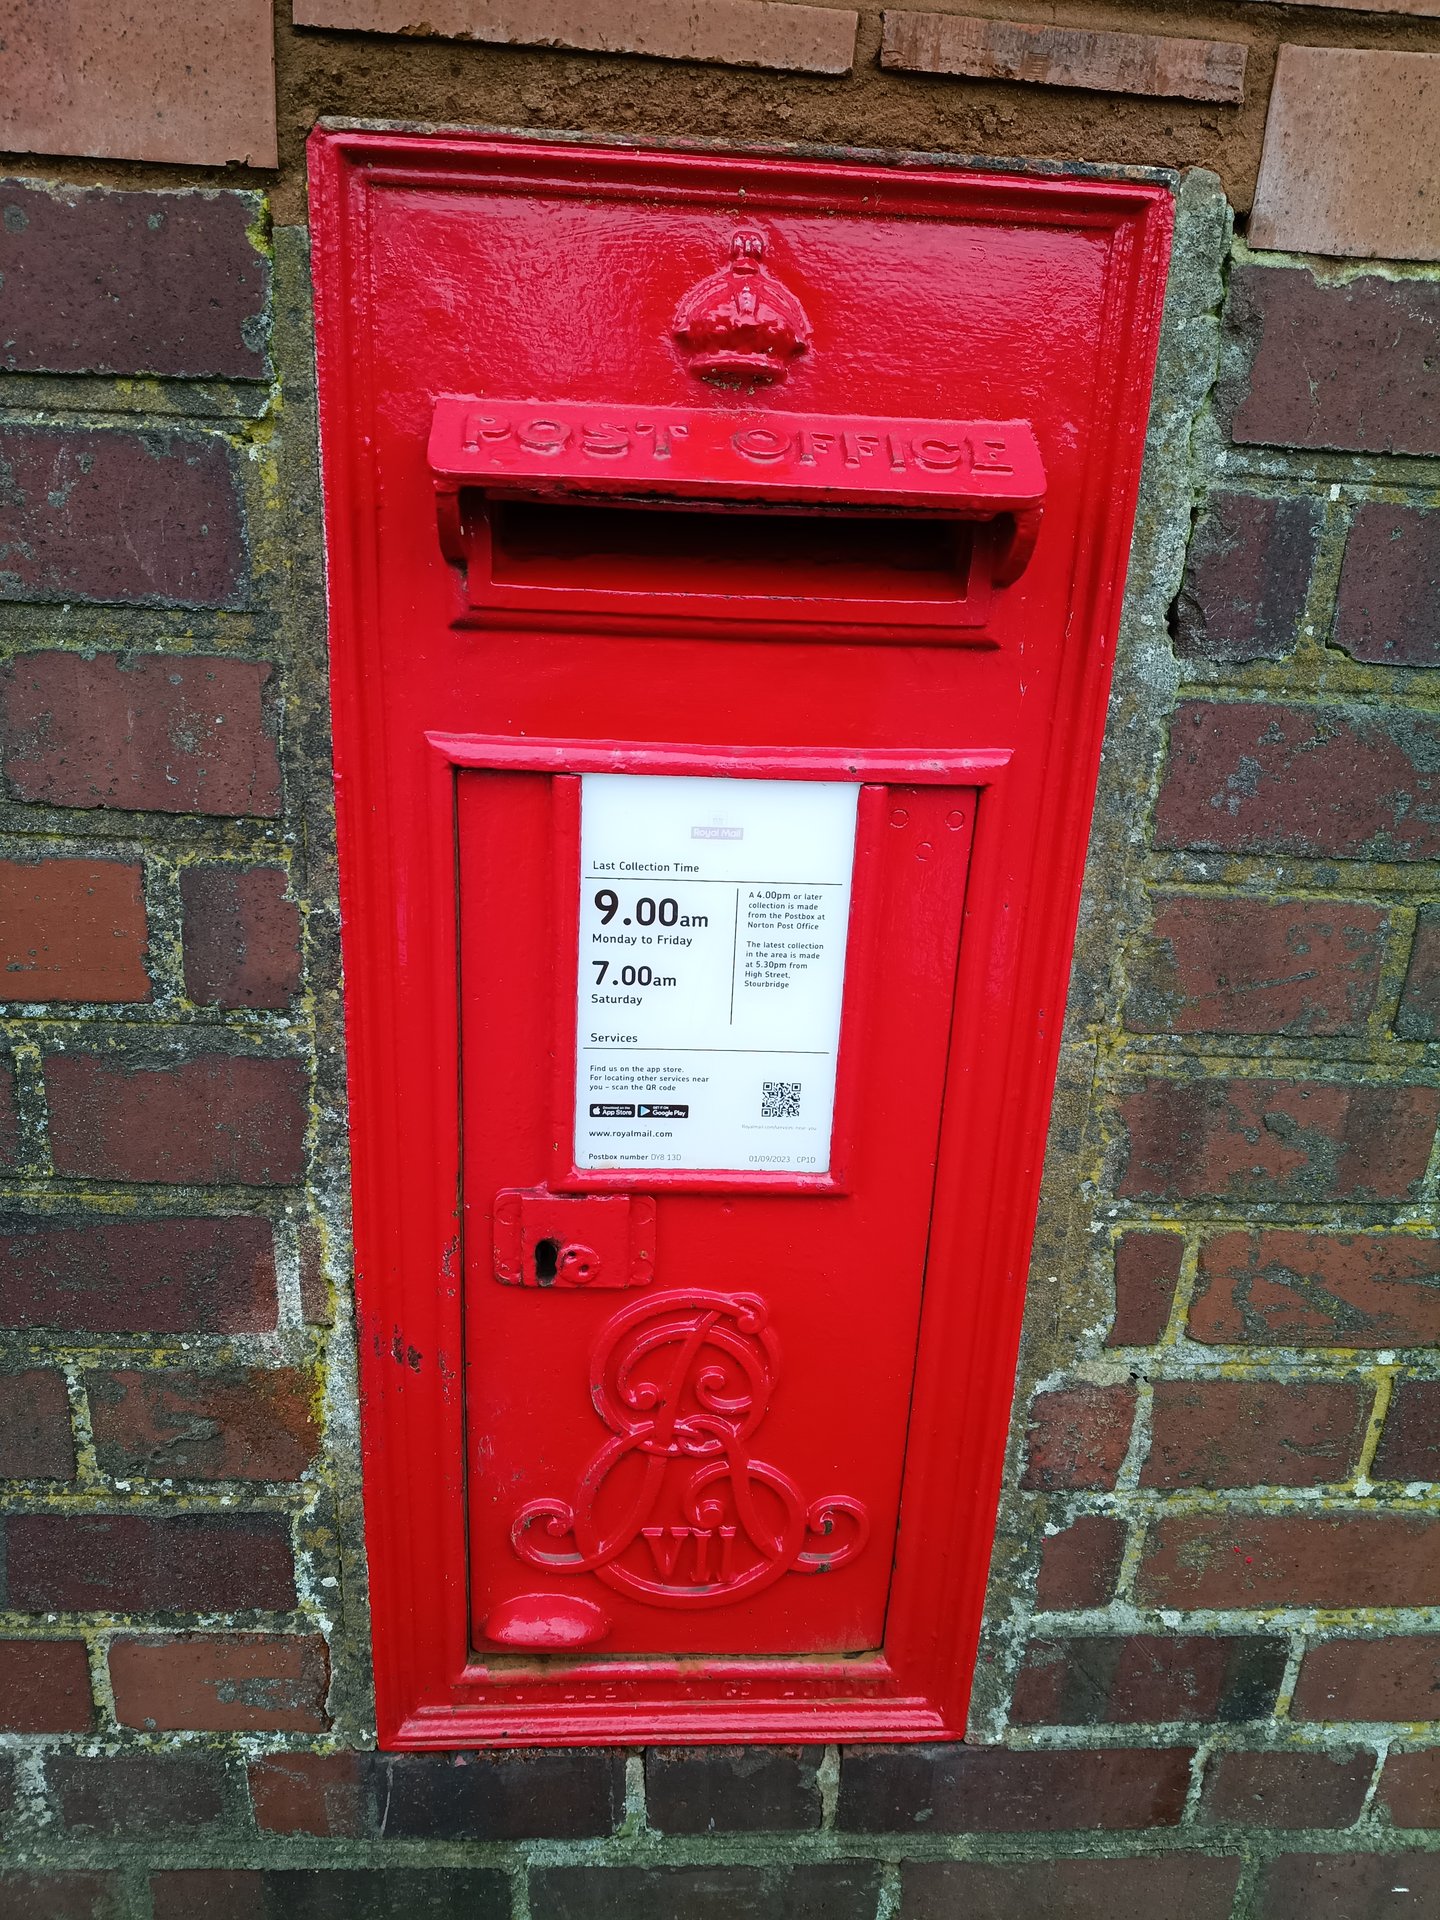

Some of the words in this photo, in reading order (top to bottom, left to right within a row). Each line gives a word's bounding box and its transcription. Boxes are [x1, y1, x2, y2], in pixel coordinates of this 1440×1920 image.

[463, 413, 689, 460] POST
[734, 428, 1015, 475] OFFICE
[693, 828, 719, 838] Royal
[721, 829, 741, 838] Mail
[593, 861, 615, 871] Last
[619, 861, 669, 872] Collection
[674, 863, 699, 872] Time
[757, 891, 791, 900] 4.00pm
[805, 893, 822, 901] later
[594, 889, 708, 927] 9.00am
[749, 902, 785, 910] collection
[748, 912, 766, 920] from
[769, 912, 782, 920] the
[785, 912, 814, 920] Postbox
[592, 934, 637, 945] Monday
[642, 936, 652, 944] to
[657, 935, 692, 947] Friday
[747, 941, 760, 949] The
[788, 942, 824, 950] collection
[756, 961, 786, 969] 5.30pm
[592, 960, 676, 987] 7.00am
[745, 971, 762, 979] High
[745, 980, 789, 989] Stourbridge
[592, 994, 642, 1006] Saturday
[591, 1033, 637, 1043] Services
[605, 1074, 634, 1083] locating
[646, 1084, 656, 1092] QR
[589, 1129, 672, 1138] www.royalmail.com
[642, 1526, 736, 1583] VII
